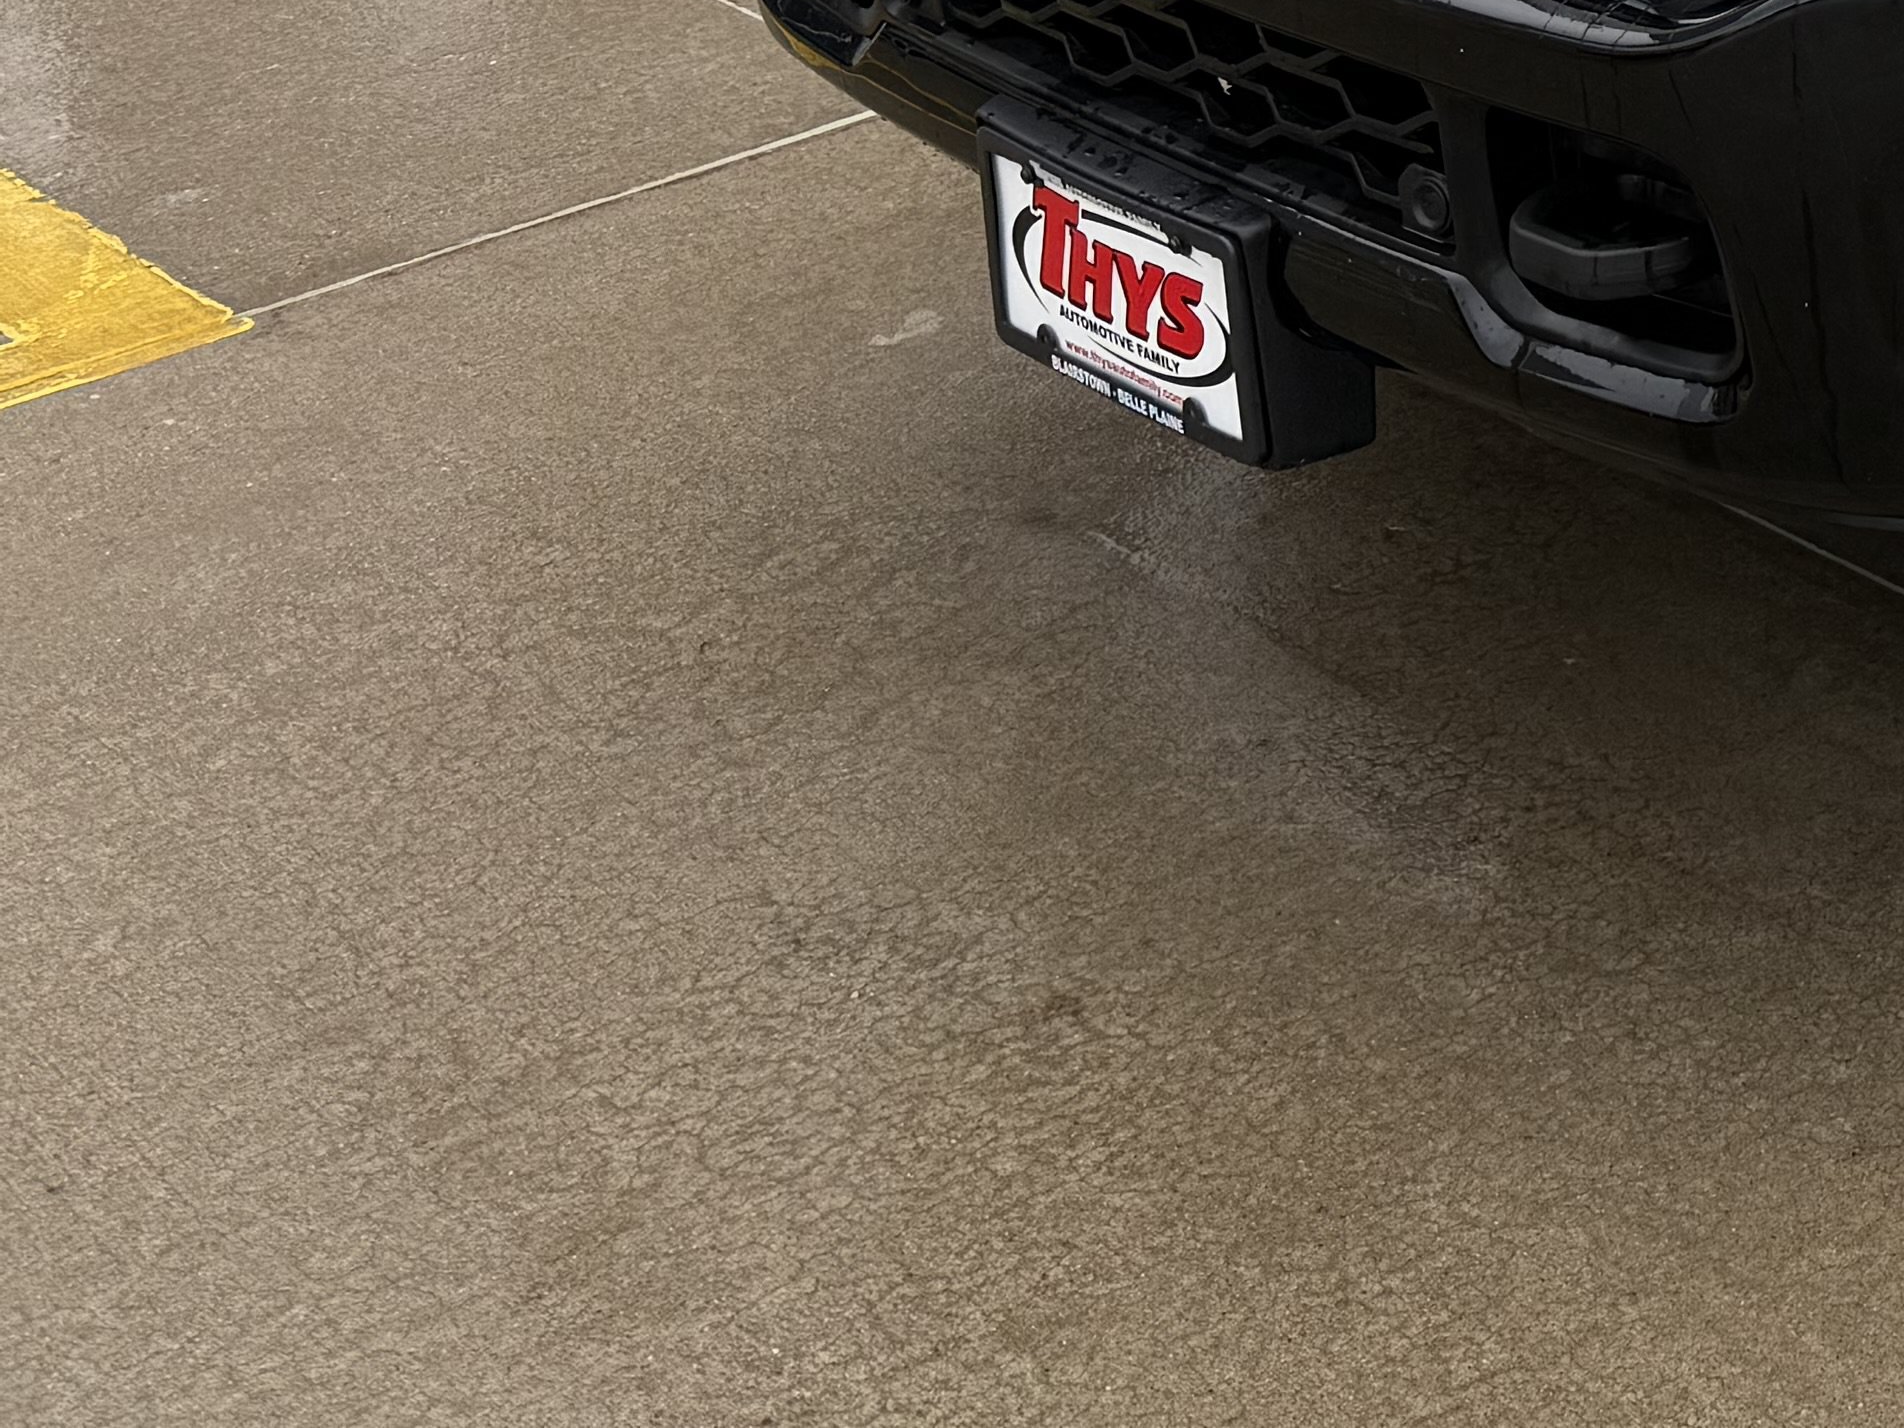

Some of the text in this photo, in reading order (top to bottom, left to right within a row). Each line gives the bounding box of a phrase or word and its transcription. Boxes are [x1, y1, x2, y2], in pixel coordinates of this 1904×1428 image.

[1032, 183, 1205, 360] THYS
[1060, 304, 1180, 375] AUTOMOTIVE FAMILY
[1051, 354, 1185, 435] BLAIRSTOWN BELLE PLAINE
